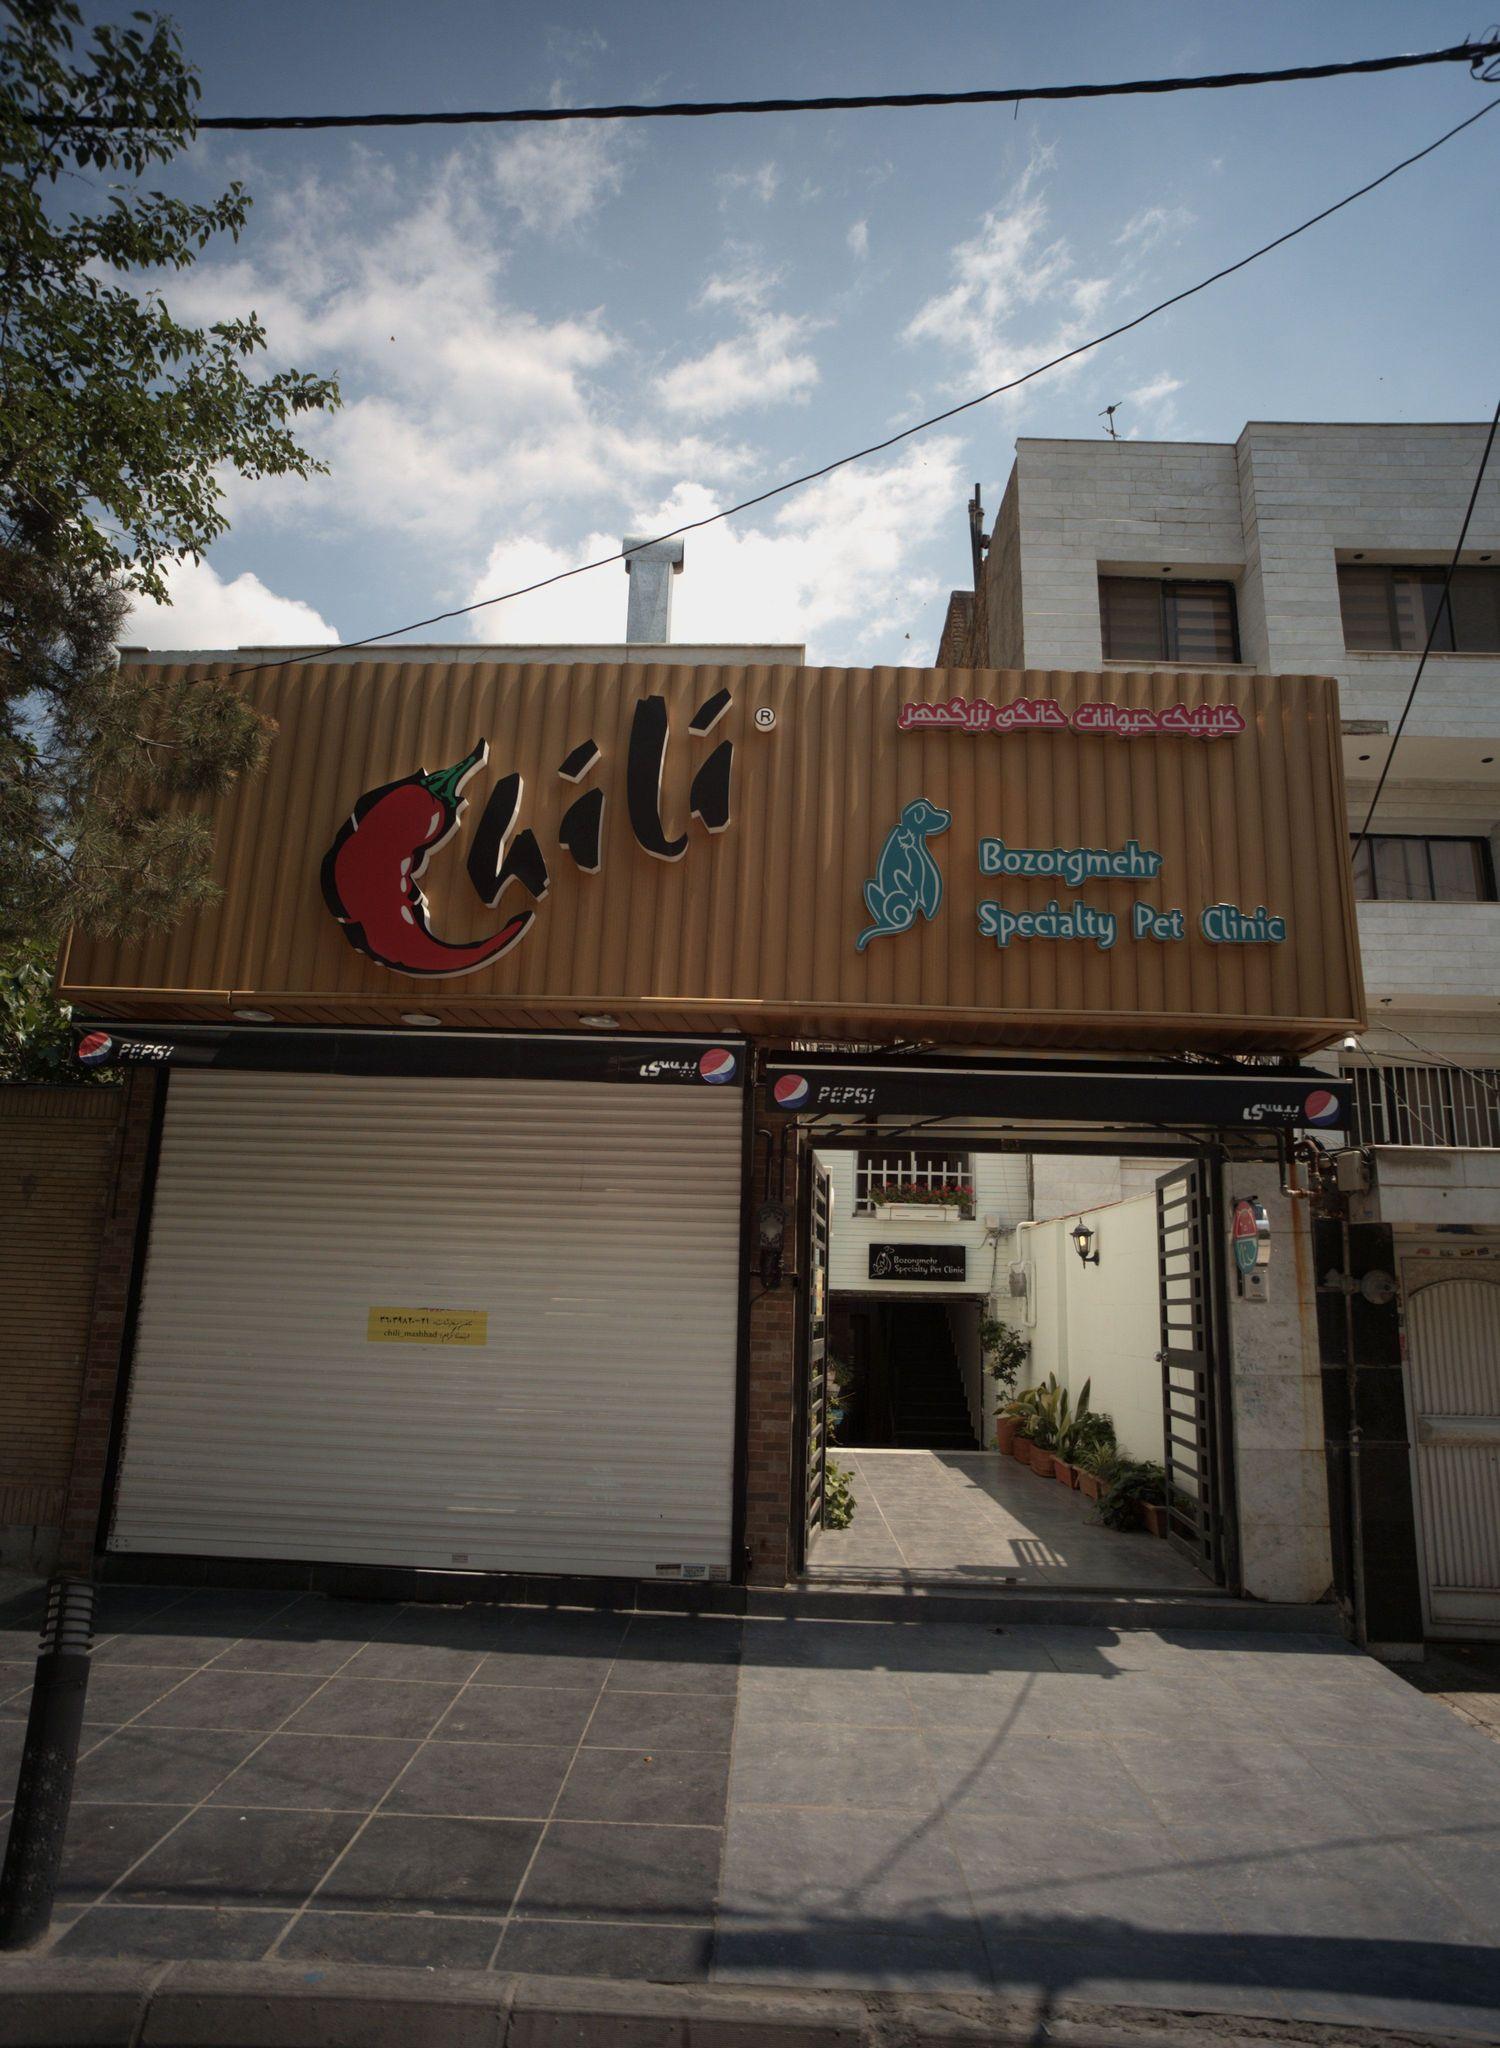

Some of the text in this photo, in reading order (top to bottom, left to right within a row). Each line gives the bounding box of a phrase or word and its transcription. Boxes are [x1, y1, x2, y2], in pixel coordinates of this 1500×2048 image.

[903, 701, 1242, 733] کلینیک حیوانات خانگی بزرگمهر
[981, 841, 1161, 884] Bozorgmehr
[979, 902, 1285, 946] Specialty Pet Clinic
[118, 1043, 175, 1061] PEPSI
[639, 1060, 698, 1078] پپسی
[816, 1086, 877, 1104] PEPSI
[1242, 1103, 1300, 1121] پپسی
[943, 1265, 964, 1275] Clinic
